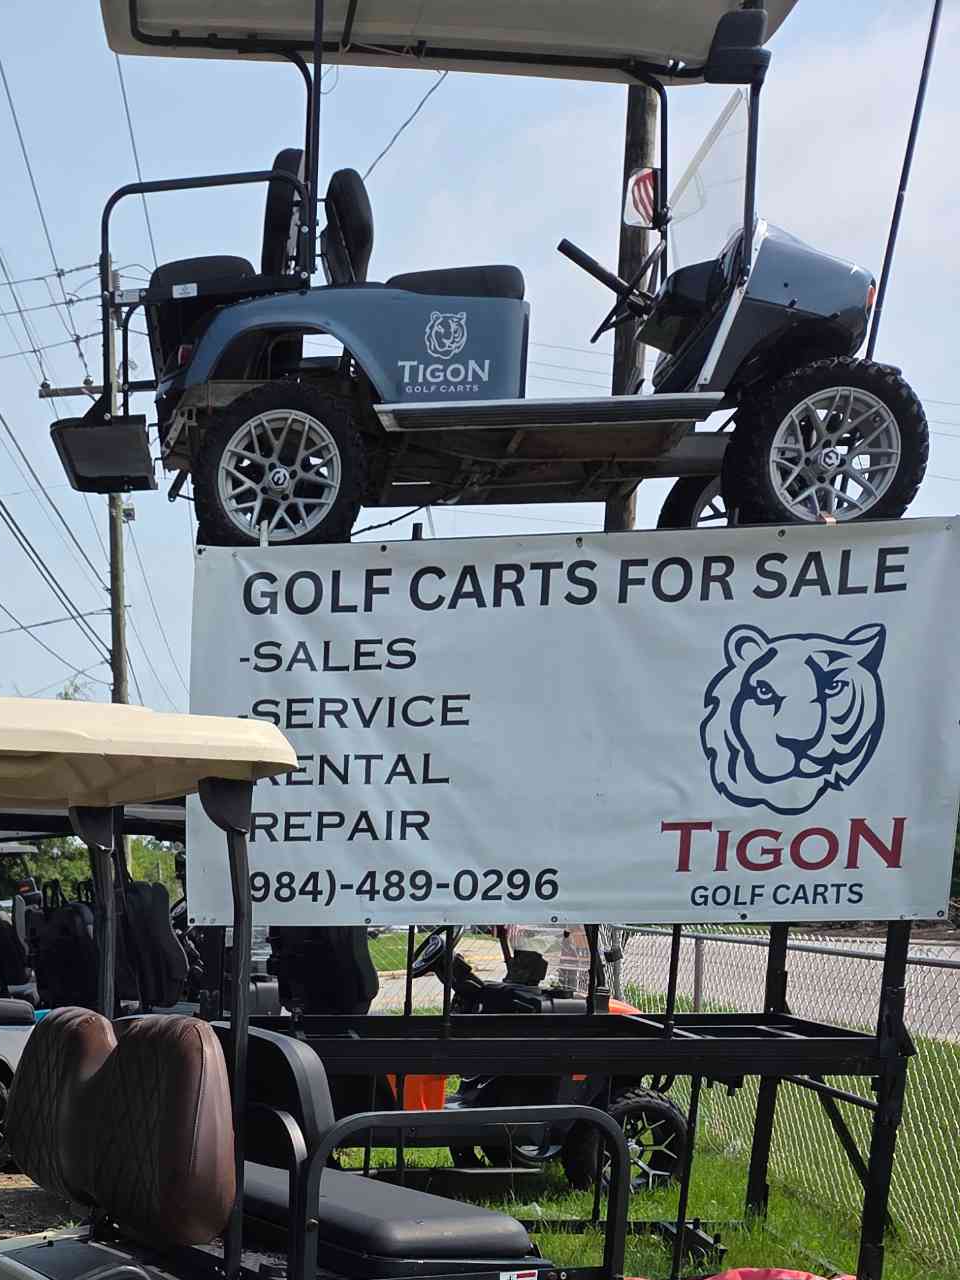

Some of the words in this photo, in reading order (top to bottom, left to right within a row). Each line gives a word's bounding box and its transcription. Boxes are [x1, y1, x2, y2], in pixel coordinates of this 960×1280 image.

[398, 360, 490, 383] TIGON
[406, 385, 437, 393] GOLF
[440, 384, 480, 393] CARTS
[243, 568, 392, 616] GOLF
[409, 560, 598, 611] CARTS
[618, 556, 735, 603] FOR
[752, 546, 910, 599] SALE
[240, 638, 417, 672] -SALES
[254, 753, 449, 785] ENTAL
[249, 810, 431, 842] REPAIR
[661, 817, 907, 872] TIGON
[691, 885, 765, 906] GOLF
[772, 883, 864, 905] CARTS
